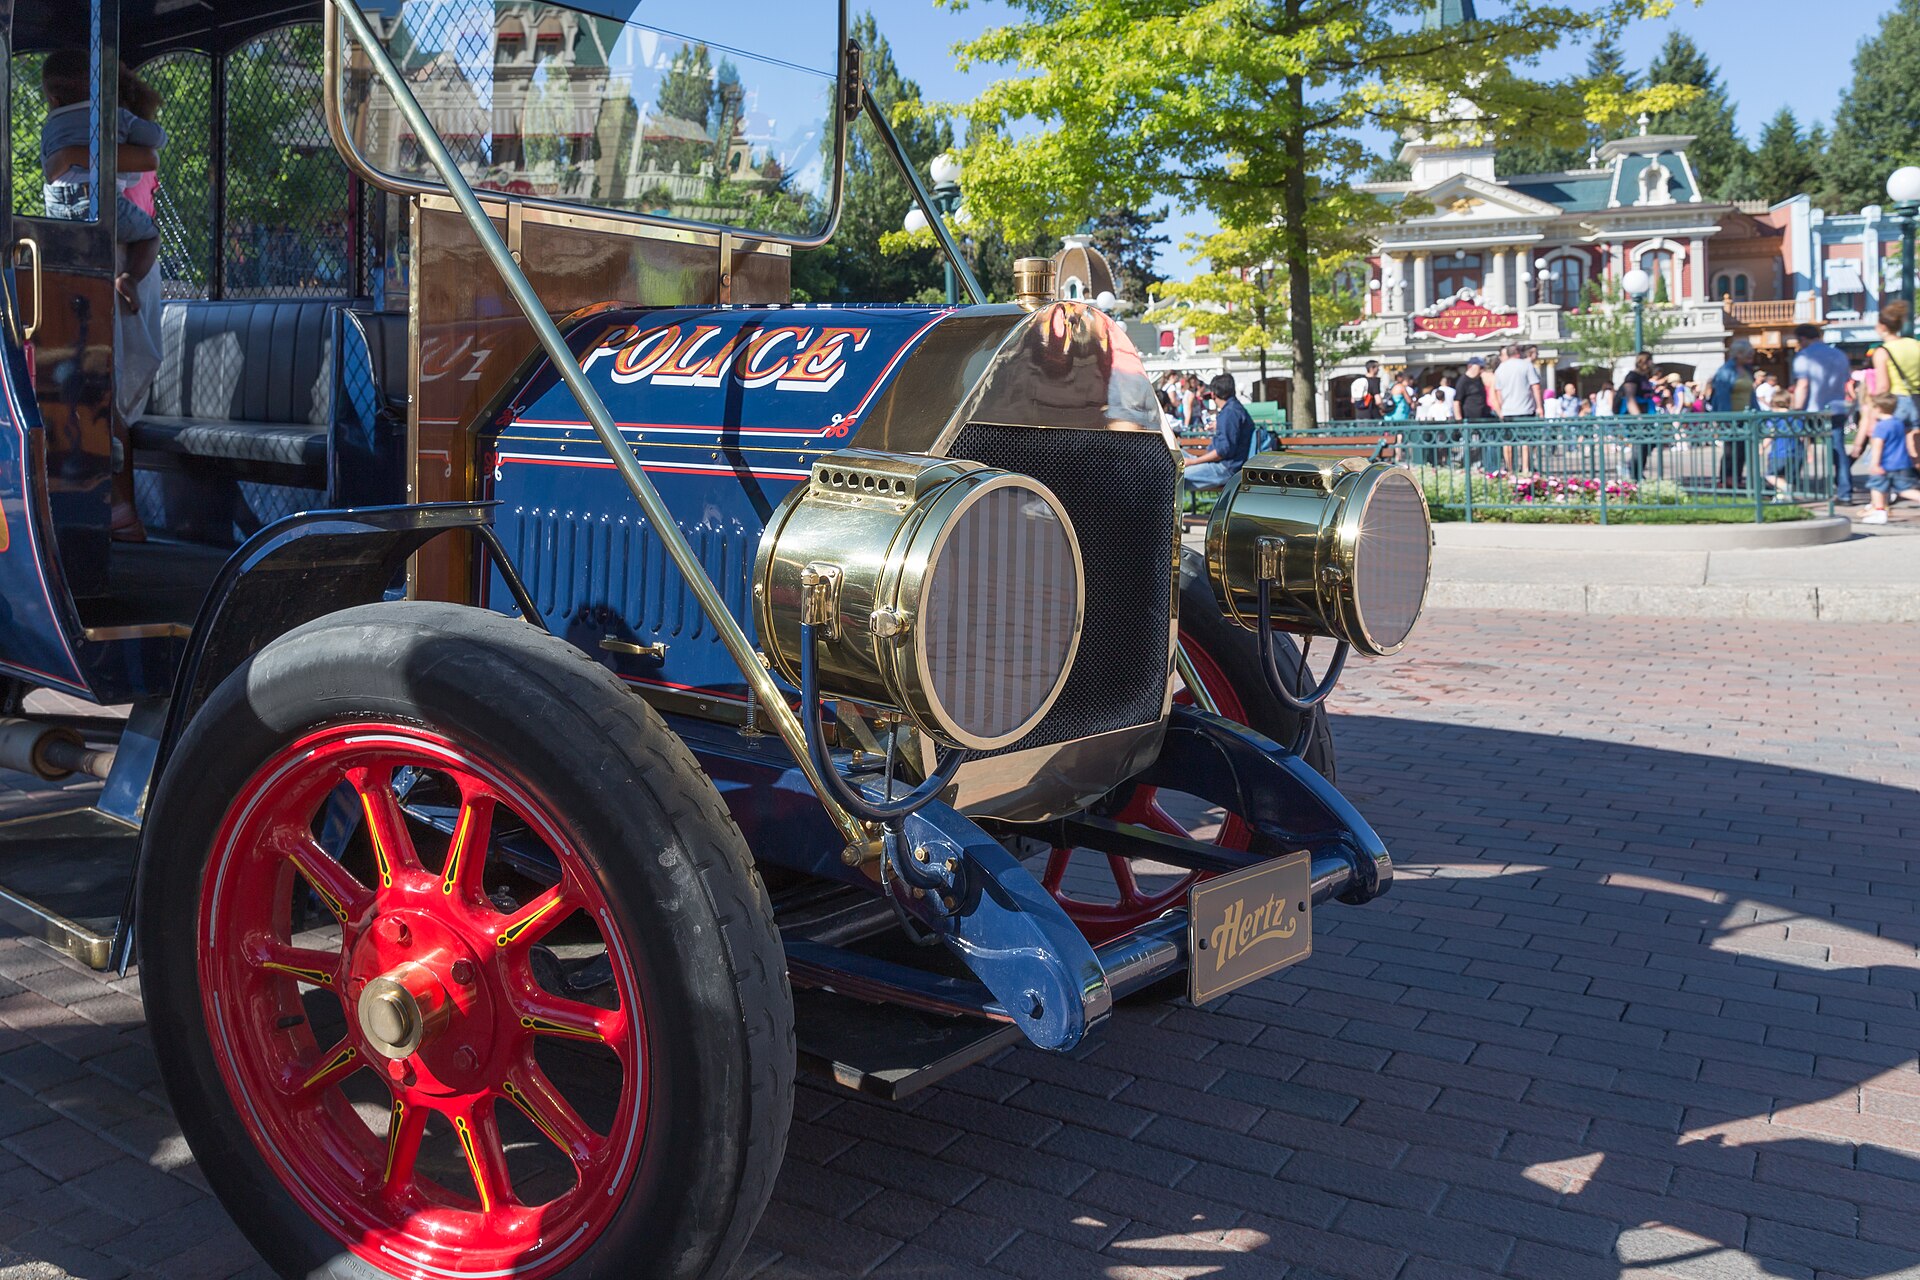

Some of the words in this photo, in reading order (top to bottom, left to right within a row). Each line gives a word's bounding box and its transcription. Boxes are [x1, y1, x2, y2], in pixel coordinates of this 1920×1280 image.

[1422, 317, 1461, 330] CITY
[1467, 315, 1511, 329] HALL
[575, 324, 871, 392] POLICE
[1210, 893, 1290, 972] Hertz
